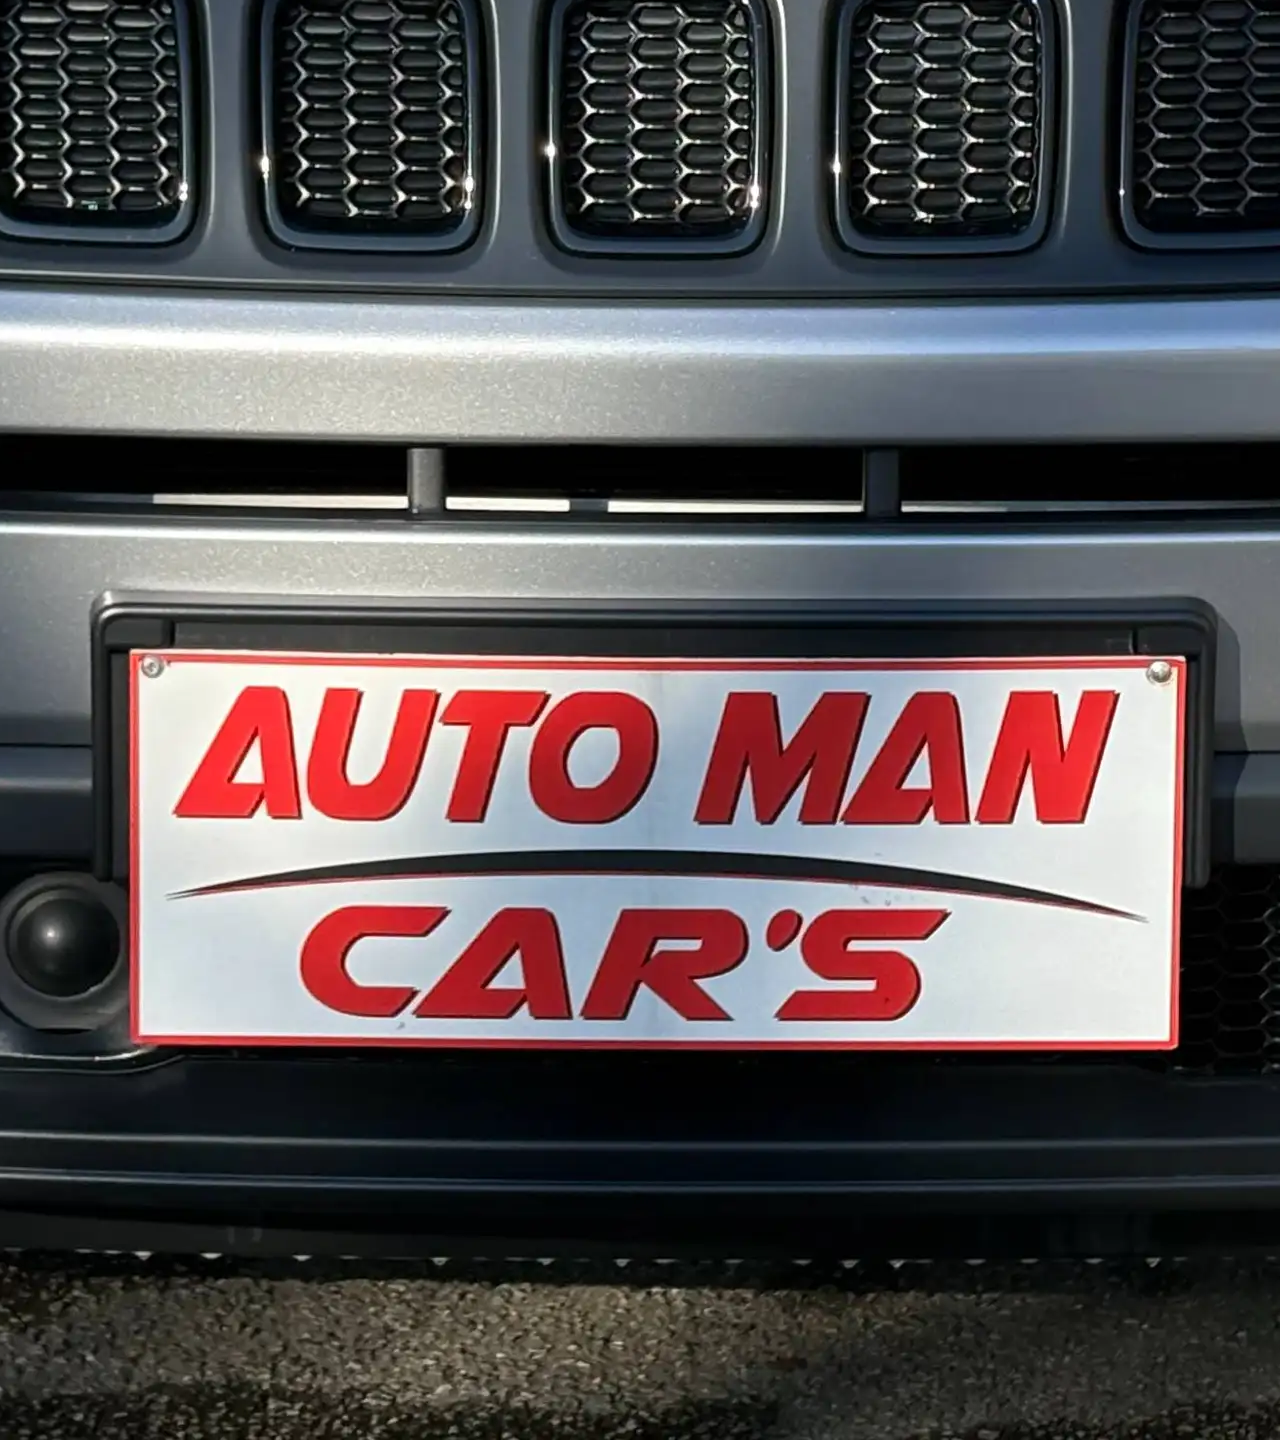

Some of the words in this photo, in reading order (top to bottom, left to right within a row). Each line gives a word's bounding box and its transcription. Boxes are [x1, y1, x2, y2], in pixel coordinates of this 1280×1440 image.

[172, 686, 662, 826] AUTO
[693, 689, 1120, 827] MAN
[299, 905, 952, 1022] CAR'S
